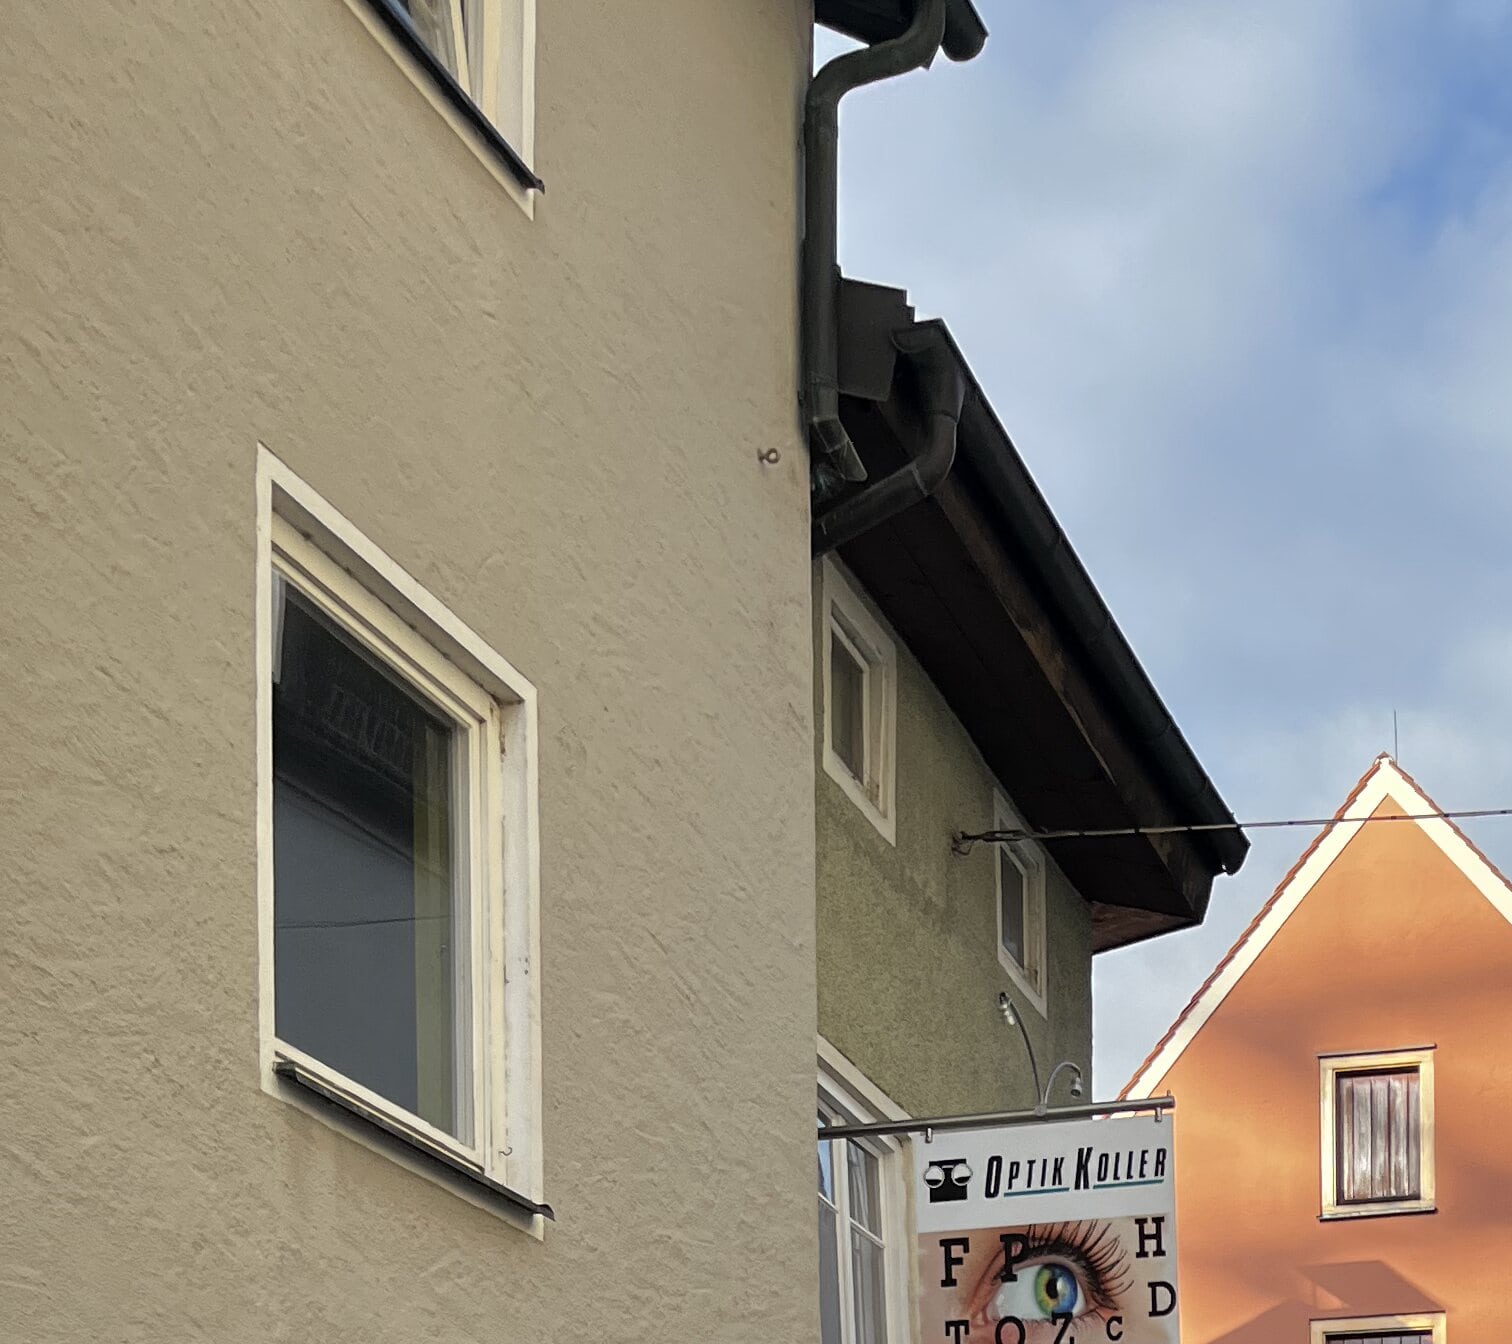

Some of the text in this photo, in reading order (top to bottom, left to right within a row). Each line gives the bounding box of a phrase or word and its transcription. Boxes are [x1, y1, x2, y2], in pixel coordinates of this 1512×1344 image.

[985, 1146, 1167, 1199] OPTIK KOLLER
[939, 1216, 1166, 1288] F P H
[1147, 1281, 1177, 1317] D
